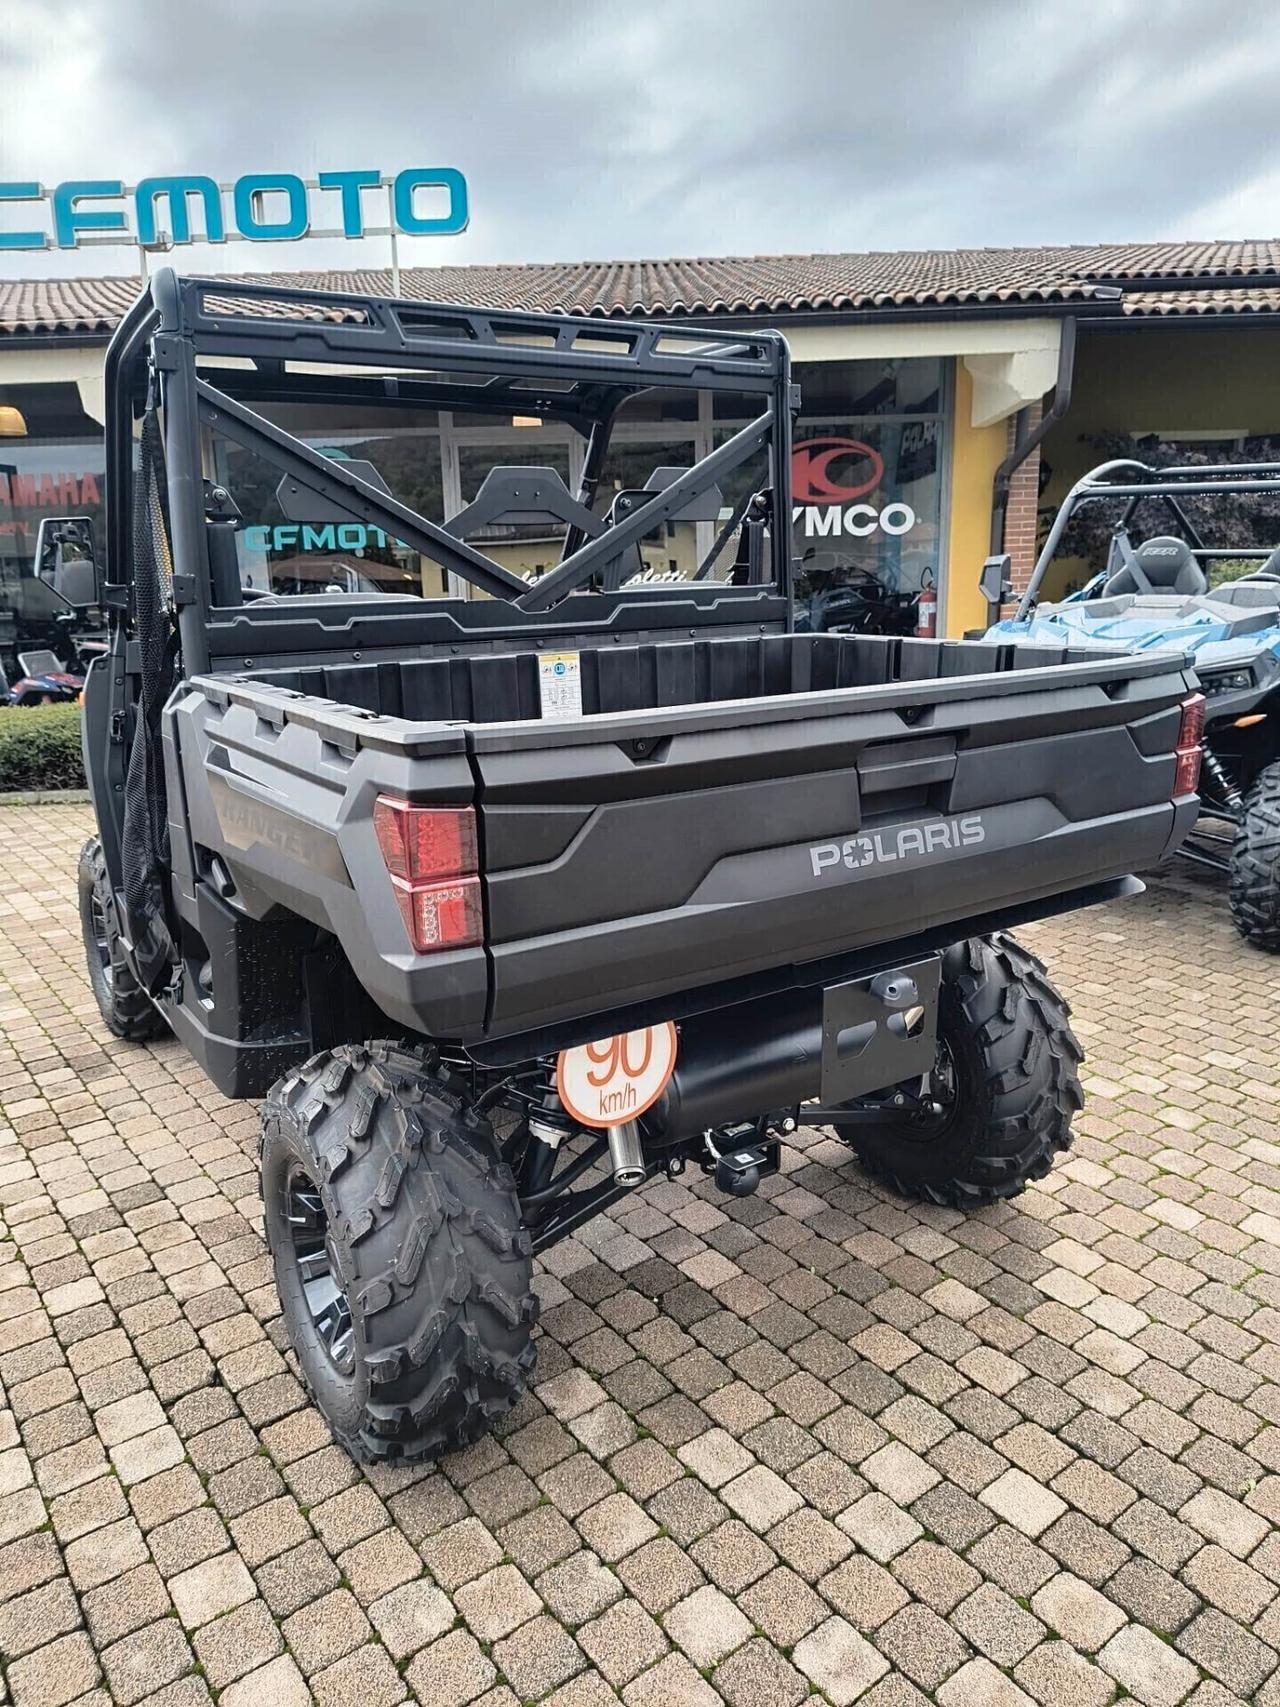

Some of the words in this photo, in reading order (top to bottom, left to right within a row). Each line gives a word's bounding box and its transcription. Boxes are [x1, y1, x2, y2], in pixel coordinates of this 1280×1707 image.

[244, 523, 411, 551] CFMOT
[810, 816, 985, 876] POLARIS
[586, 1026, 653, 1087] 90
[600, 1082, 637, 1116] km/h
